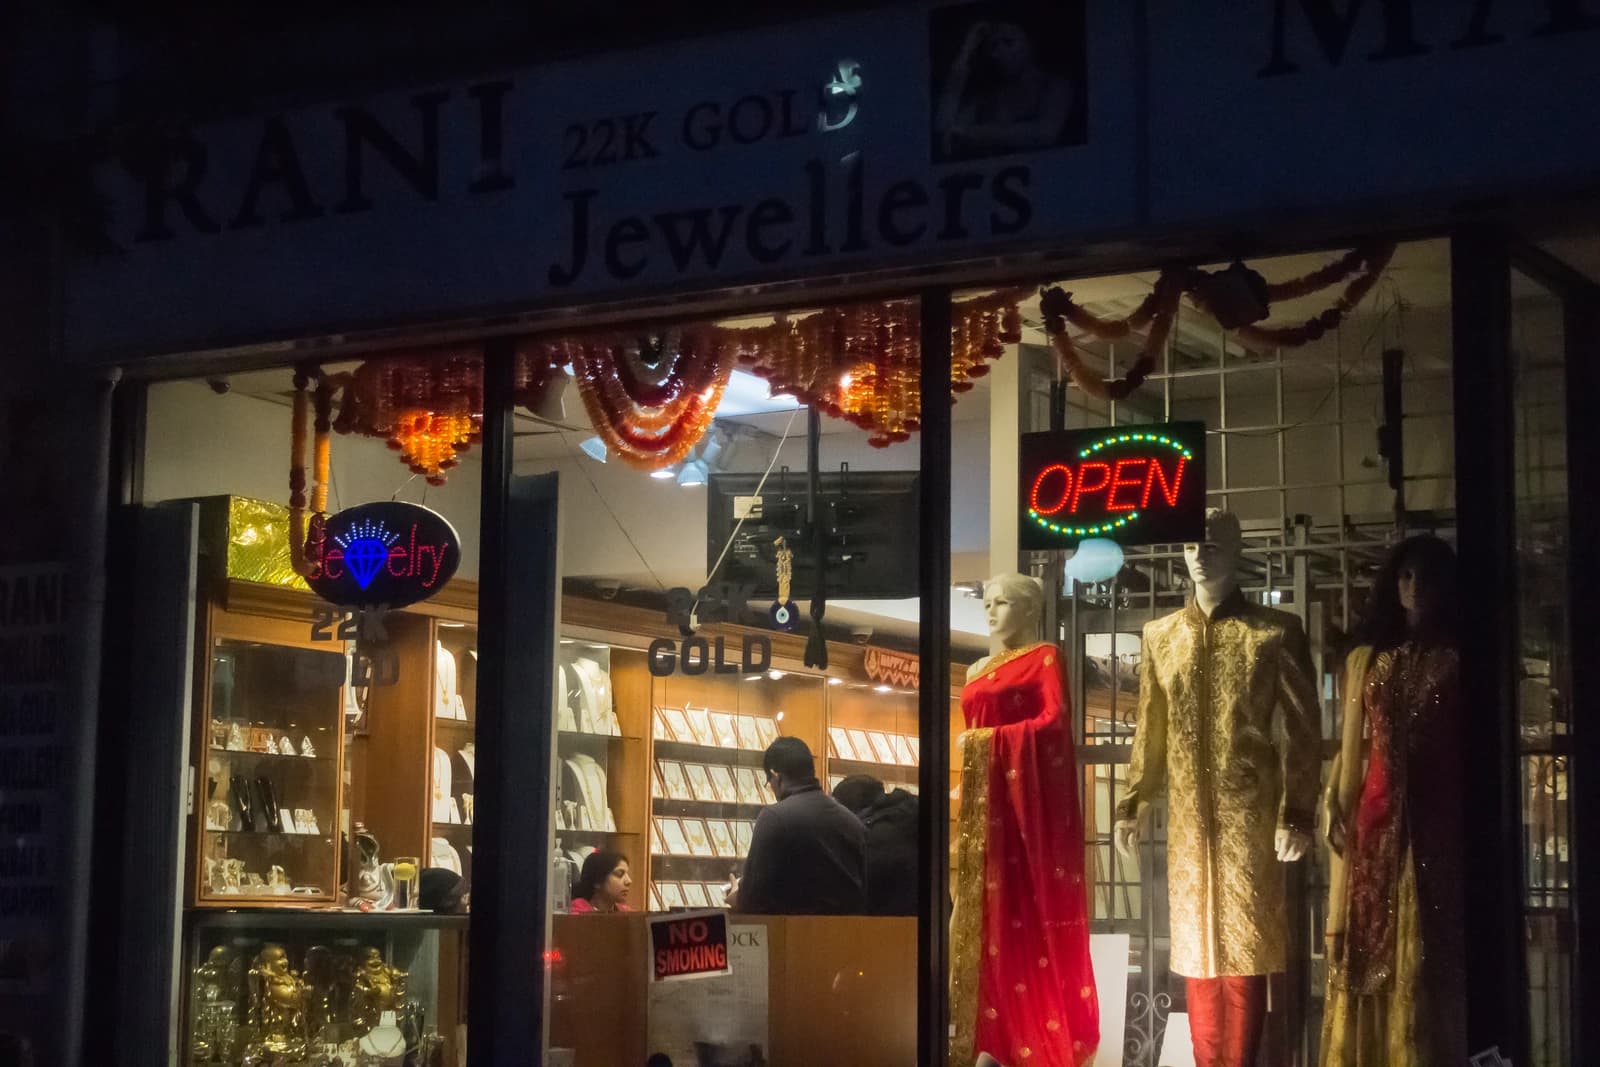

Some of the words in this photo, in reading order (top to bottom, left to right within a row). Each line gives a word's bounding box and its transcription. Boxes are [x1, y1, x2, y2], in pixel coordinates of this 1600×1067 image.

[134, 80, 514, 242] RANI
[562, 111, 658, 170] 22K
[548, 156, 1033, 288] Jewellers
[1030, 455, 1187, 515] OPEN
[311, 604, 389, 641] 22K
[648, 634, 771, 676] GOLD
[667, 919, 709, 945] NO
[656, 943, 726, 974] SMOKING
